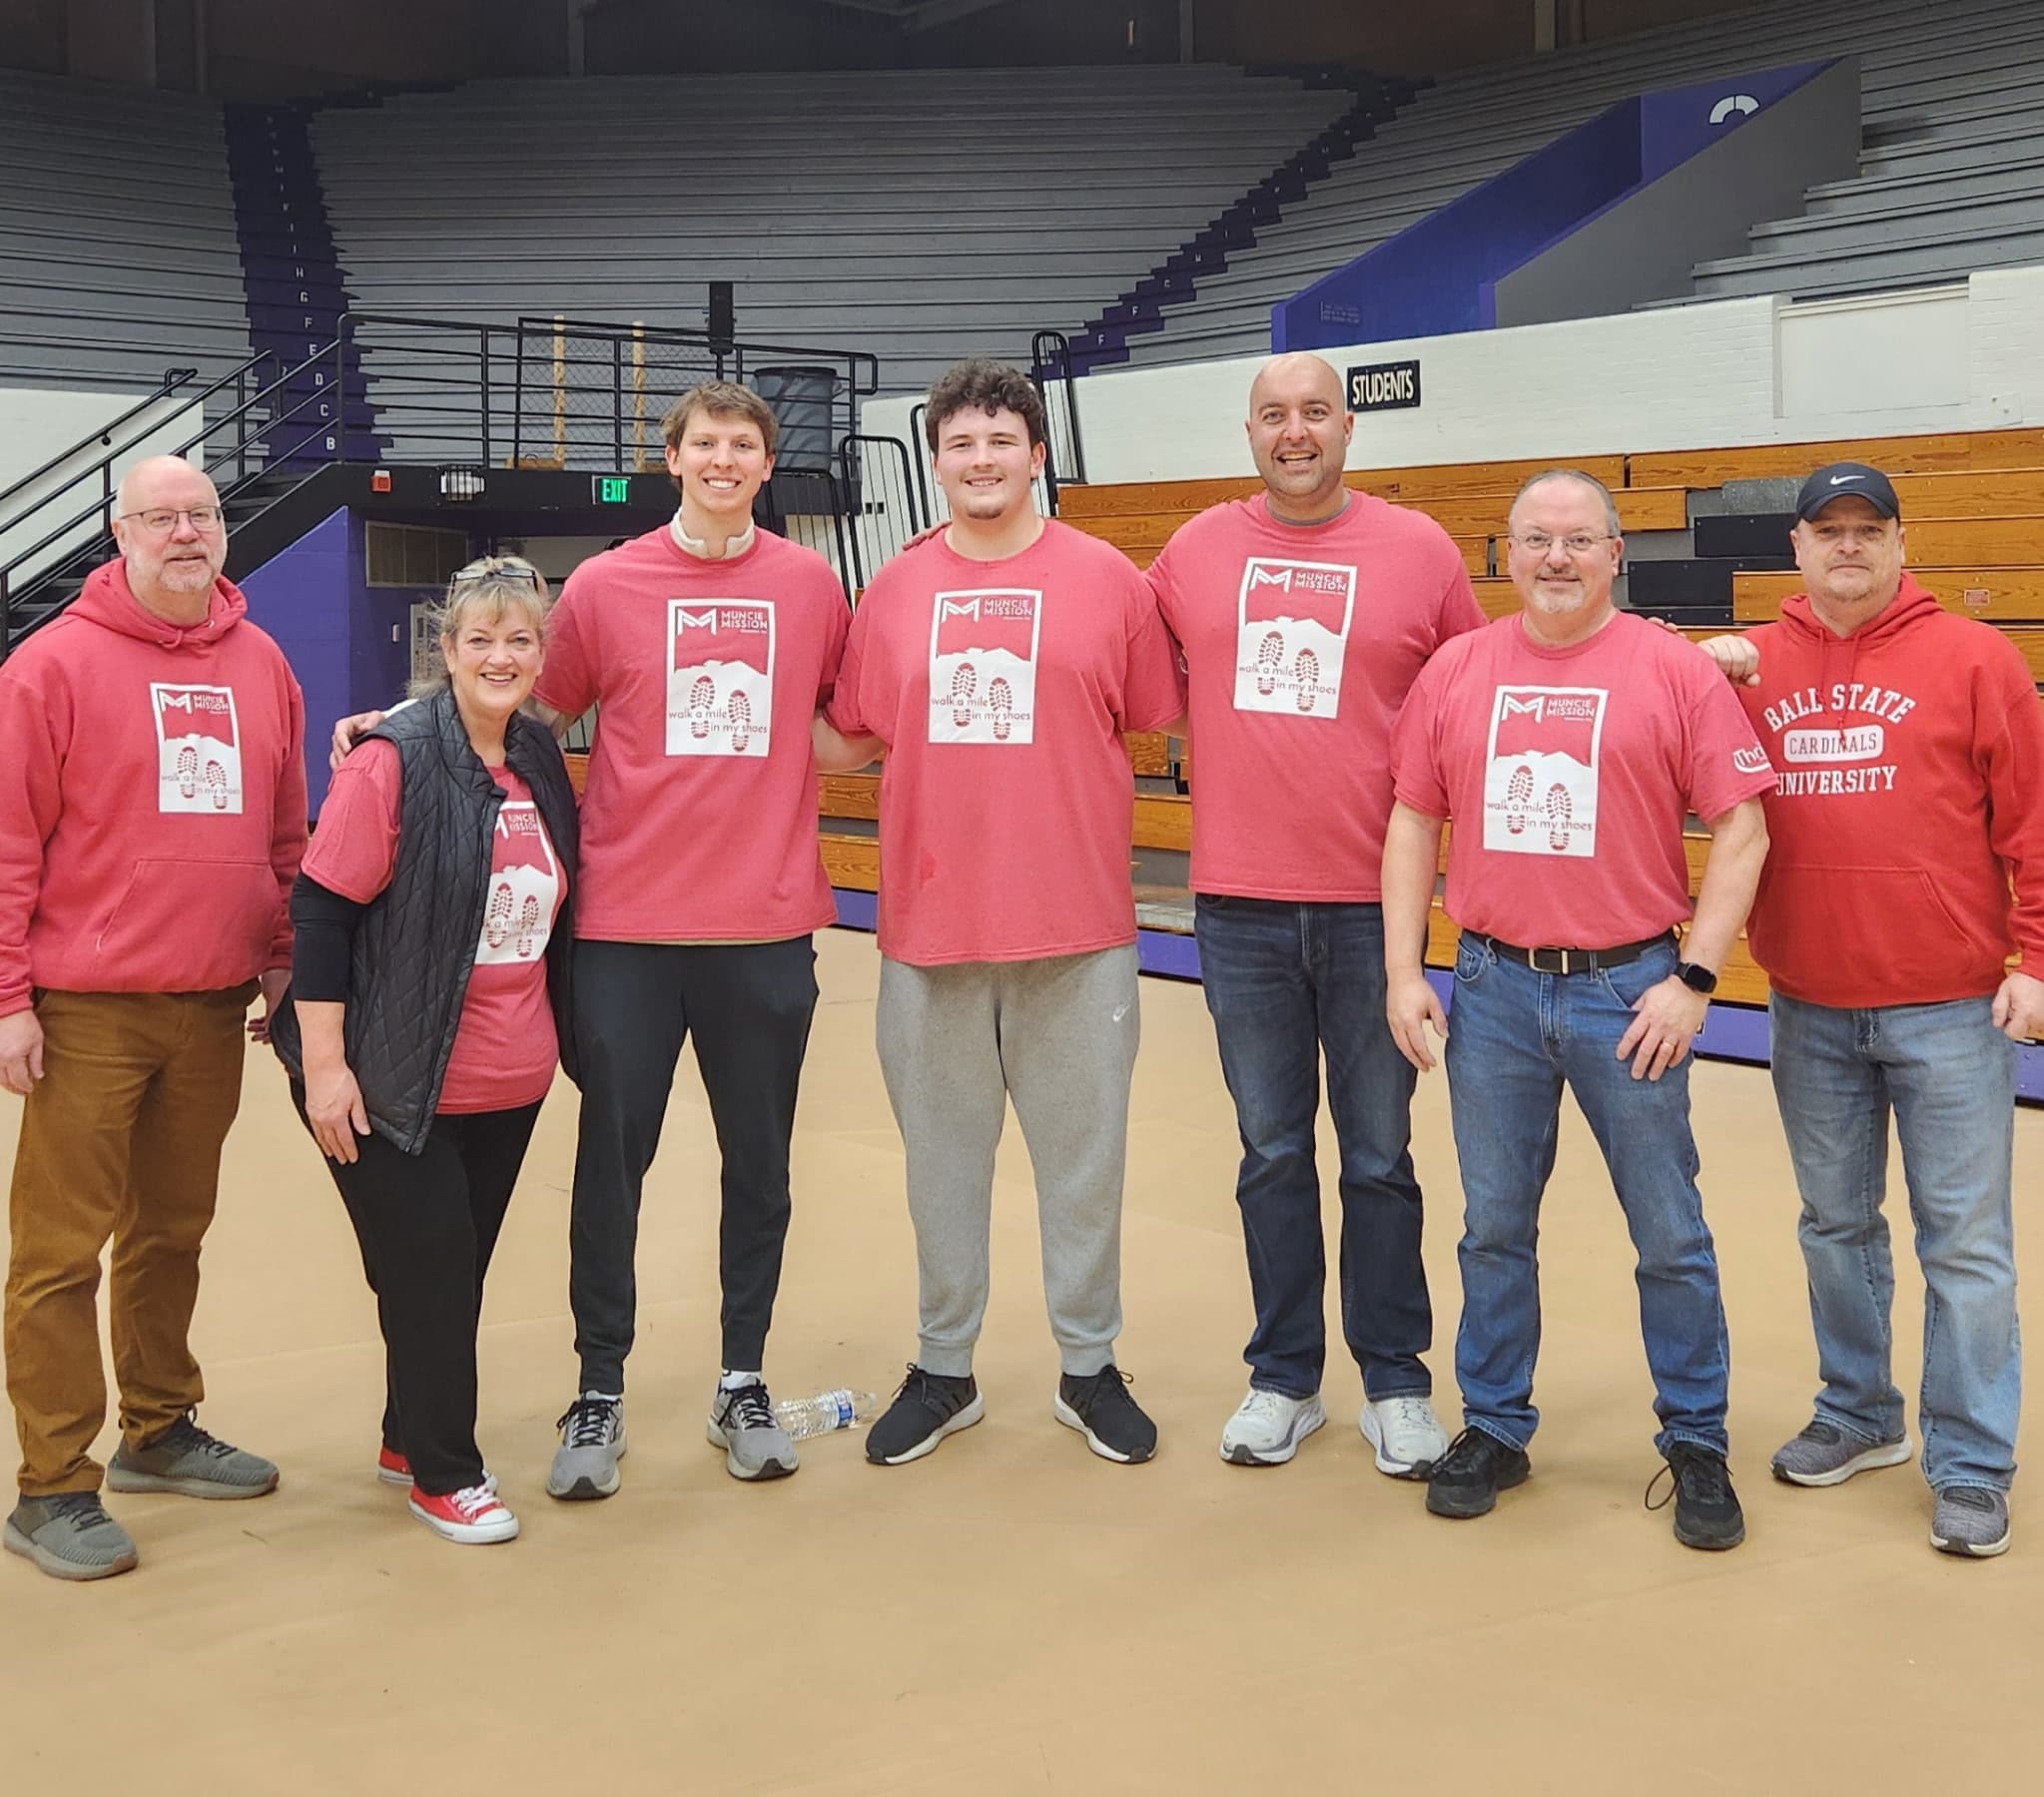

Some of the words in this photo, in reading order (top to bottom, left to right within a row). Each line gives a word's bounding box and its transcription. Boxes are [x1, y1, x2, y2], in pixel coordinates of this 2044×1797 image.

[305, 317, 313, 328] F
[309, 343, 318, 356] E
[315, 372, 324, 386] D
[1352, 368, 1414, 405] STUDENTS
[321, 404, 330, 417] C
[326, 437, 337, 450] B
[602, 479, 627, 502] EXIT
[1296, 572, 1343, 583] MUNCIE
[1294, 579, 1347, 591] MISSION
[985, 599, 1029, 608] MUNCIE
[721, 611, 763, 621] MUNCIE
[984, 607, 1032, 616] MISSION
[721, 619, 768, 629] MISSION
[1238, 663, 1259, 674] walk
[1272, 665, 1294, 676] mile
[1288, 683, 1305, 692] my
[1308, 682, 1337, 695] shoes
[932, 696, 955, 706] walk
[968, 697, 989, 707] mile
[1548, 699, 1592, 708] MUNCIE
[669, 708, 693, 719] walk
[705, 710, 728, 719] mile
[1547, 706, 1595, 717] MISSION
[1763, 687, 1823, 733] BALL
[1831, 684, 1916, 724] STATE
[972, 711, 982, 720] in
[985, 713, 1001, 722] my
[1004, 711, 1030, 720] shoes
[711, 722, 720, 731] in
[723, 724, 739, 734] my
[742, 723, 768, 734] shoes
[1789, 733, 1877, 755] CARDINALS
[1775, 766, 1897, 797] UNIVERSITY
[1487, 800, 1509, 811] walk
[1522, 802, 1545, 813] mile
[1527, 818, 1537, 827] in
[1540, 821, 1558, 830] my
[1561, 820, 1593, 831] shoes
